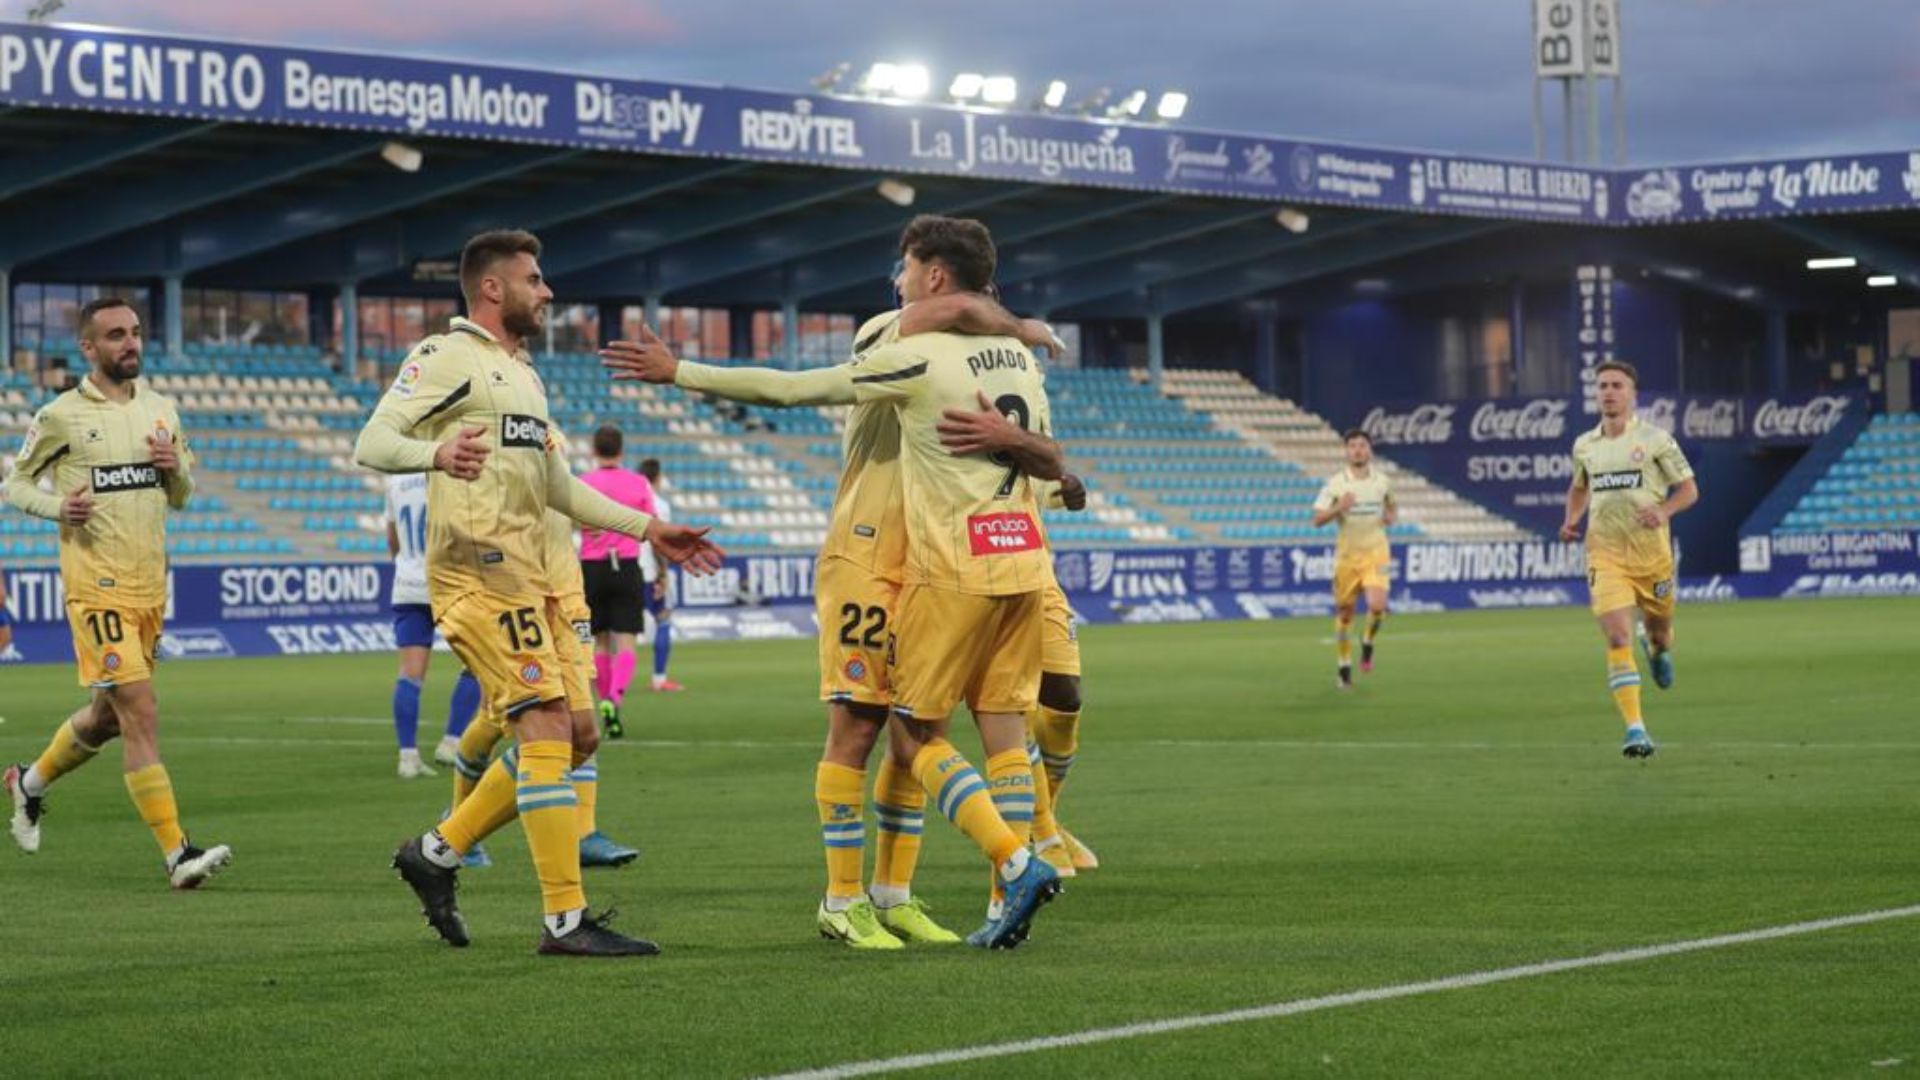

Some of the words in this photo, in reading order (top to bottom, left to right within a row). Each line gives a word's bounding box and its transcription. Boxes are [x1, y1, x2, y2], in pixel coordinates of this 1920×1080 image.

[284, 59, 447, 130] Bernesga
[451, 73, 548, 128] Motor
[910, 118, 953, 159] La
[1427, 158, 1445, 189] EL
[1508, 165, 1536, 197] DEL
[1769, 164, 1801, 209] La
[1804, 160, 1880, 197] Nube
[967, 347, 1028, 377] PUADO
[94, 466, 160, 488] betwa
[747, 558, 817, 598] FRUT
[1406, 544, 1519, 583] EMBUTIDOS
[87, 609, 124, 646] 10
[498, 606, 543, 652] 15
[840, 602, 888, 649] 22
